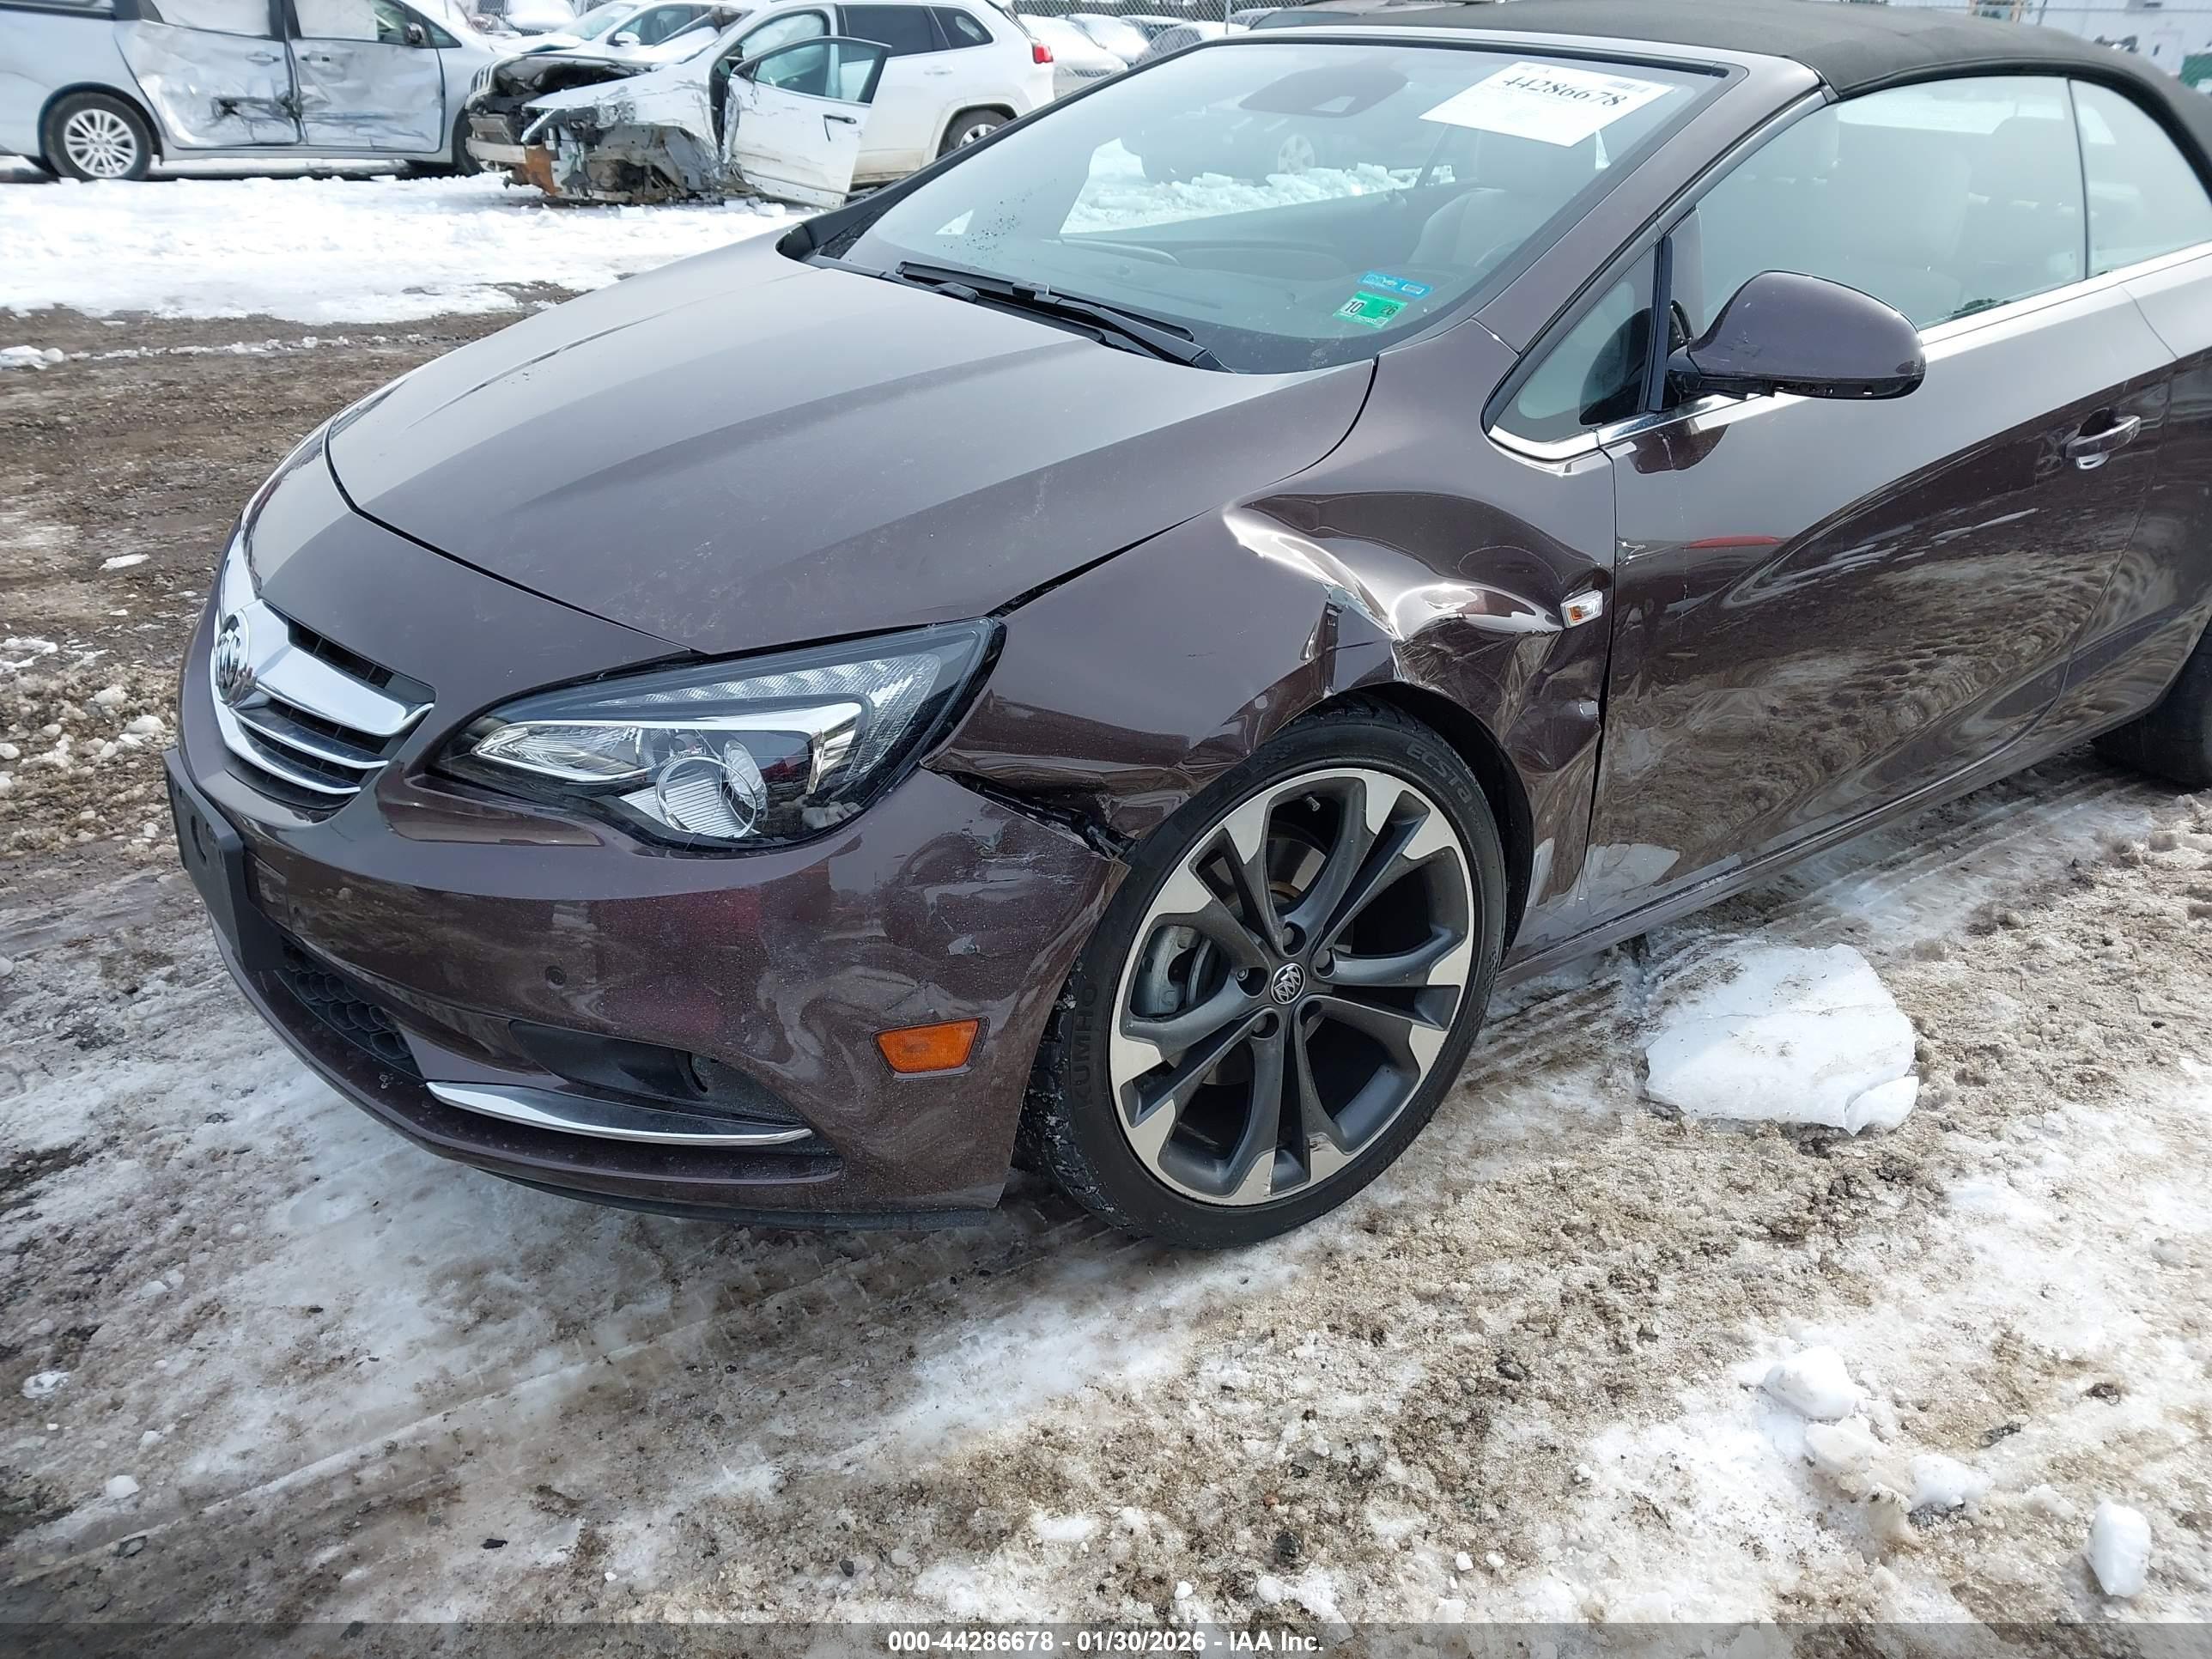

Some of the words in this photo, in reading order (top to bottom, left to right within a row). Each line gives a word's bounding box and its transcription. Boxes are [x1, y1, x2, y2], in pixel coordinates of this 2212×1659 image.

[1502, 76, 1628, 106] 44286678
[1345, 301, 1365, 313] 10
[1069, 981, 1098, 1111] KUMHO
